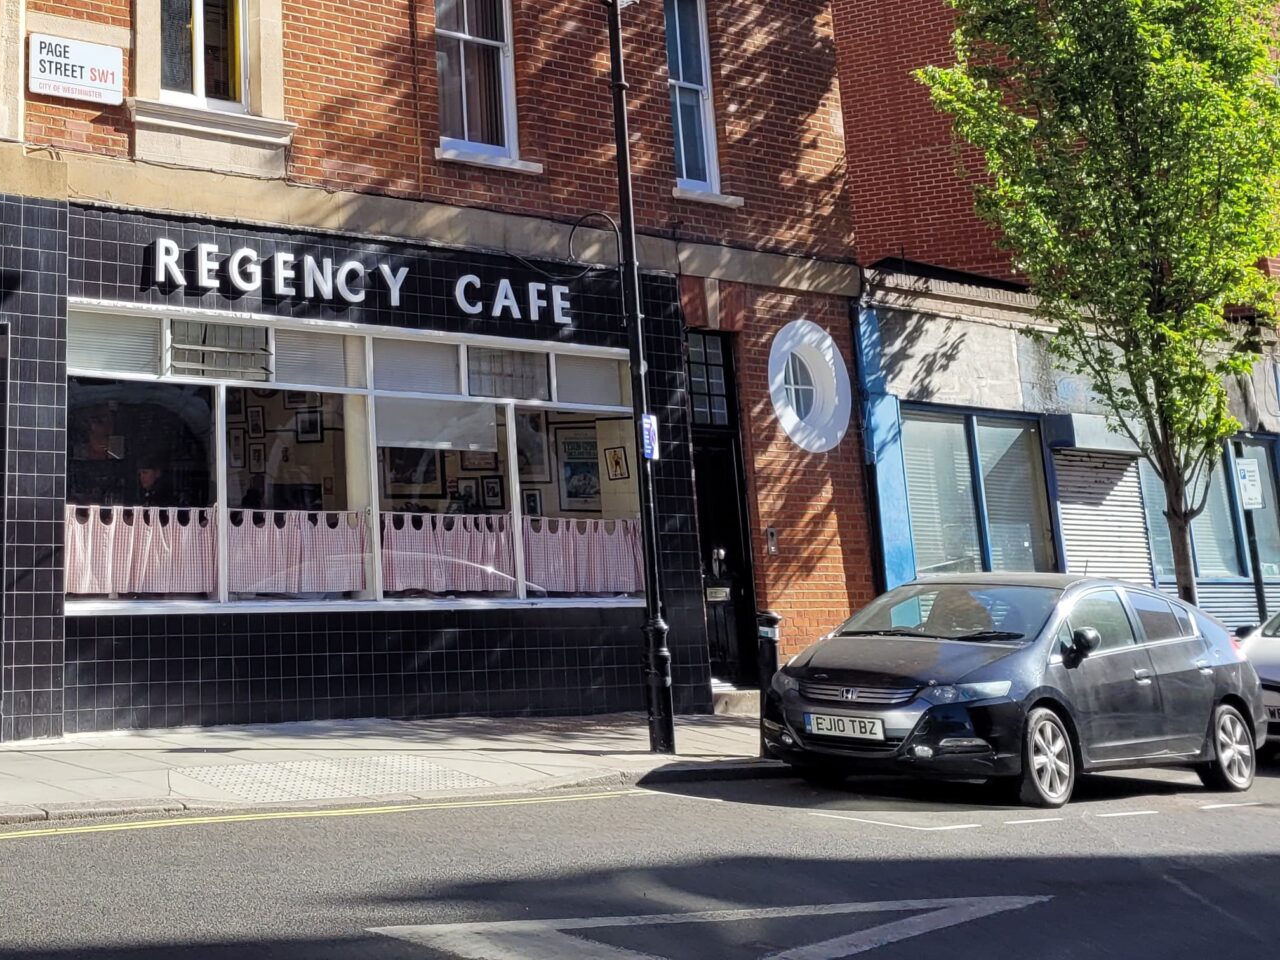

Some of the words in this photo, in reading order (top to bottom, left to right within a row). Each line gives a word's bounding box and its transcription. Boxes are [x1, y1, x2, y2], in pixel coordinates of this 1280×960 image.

[39, 40, 70, 59] PAGE
[39, 58, 85, 80] STREET
[89, 67, 115, 85] SW1
[38, 82, 51, 91] CITY
[62, 85, 102, 99] WESTMINSTER
[155, 237, 409, 307] REGENCY
[454, 273, 572, 324] CAFE
[815, 716, 846, 733] EJ10
[849, 719, 877, 735] TBZ
